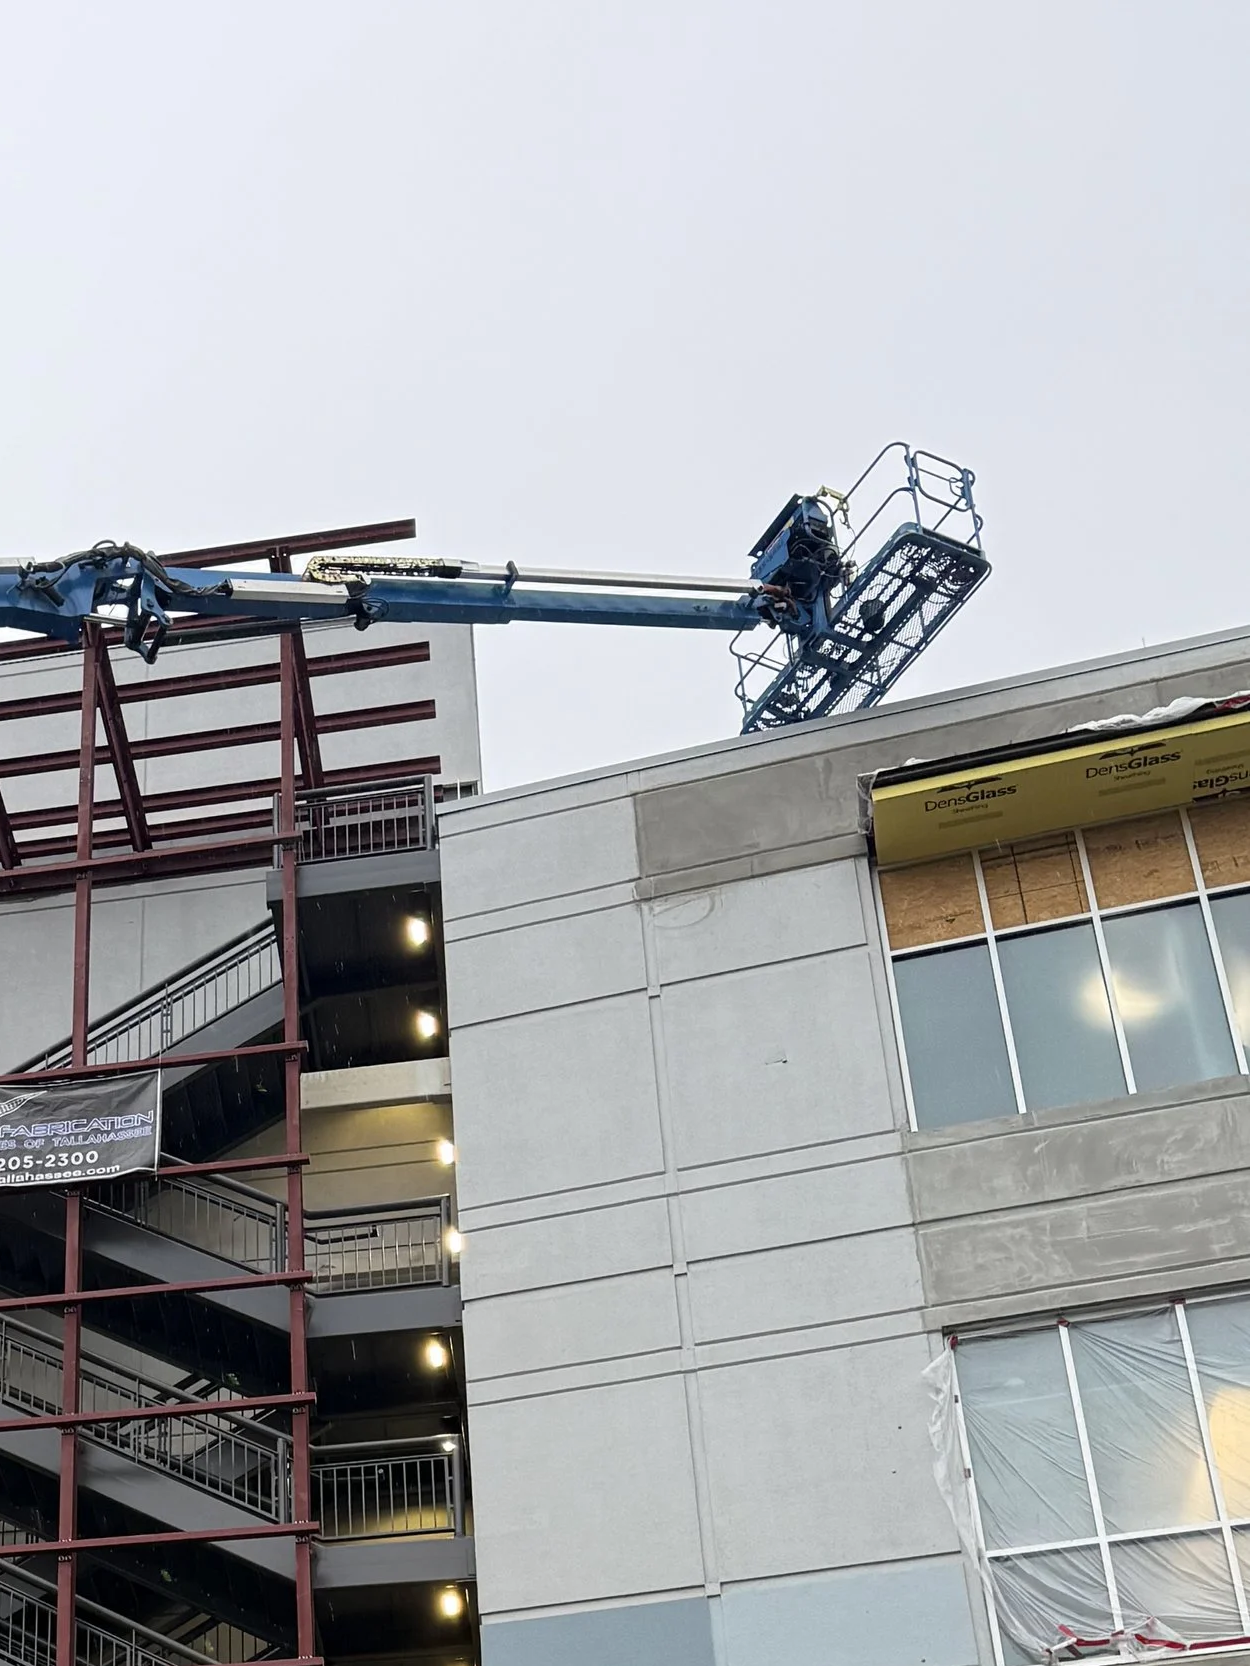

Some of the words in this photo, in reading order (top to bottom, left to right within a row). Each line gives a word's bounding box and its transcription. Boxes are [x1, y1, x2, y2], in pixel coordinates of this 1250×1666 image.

[1085, 751, 1182, 779] DensGlass
[924, 784, 1017, 812] DensGlass
[0, 1110, 154, 1138] FABRICATION
[23, 1138, 45, 1149] OF
[52, 1125, 153, 1147] TALLAHASSEE
